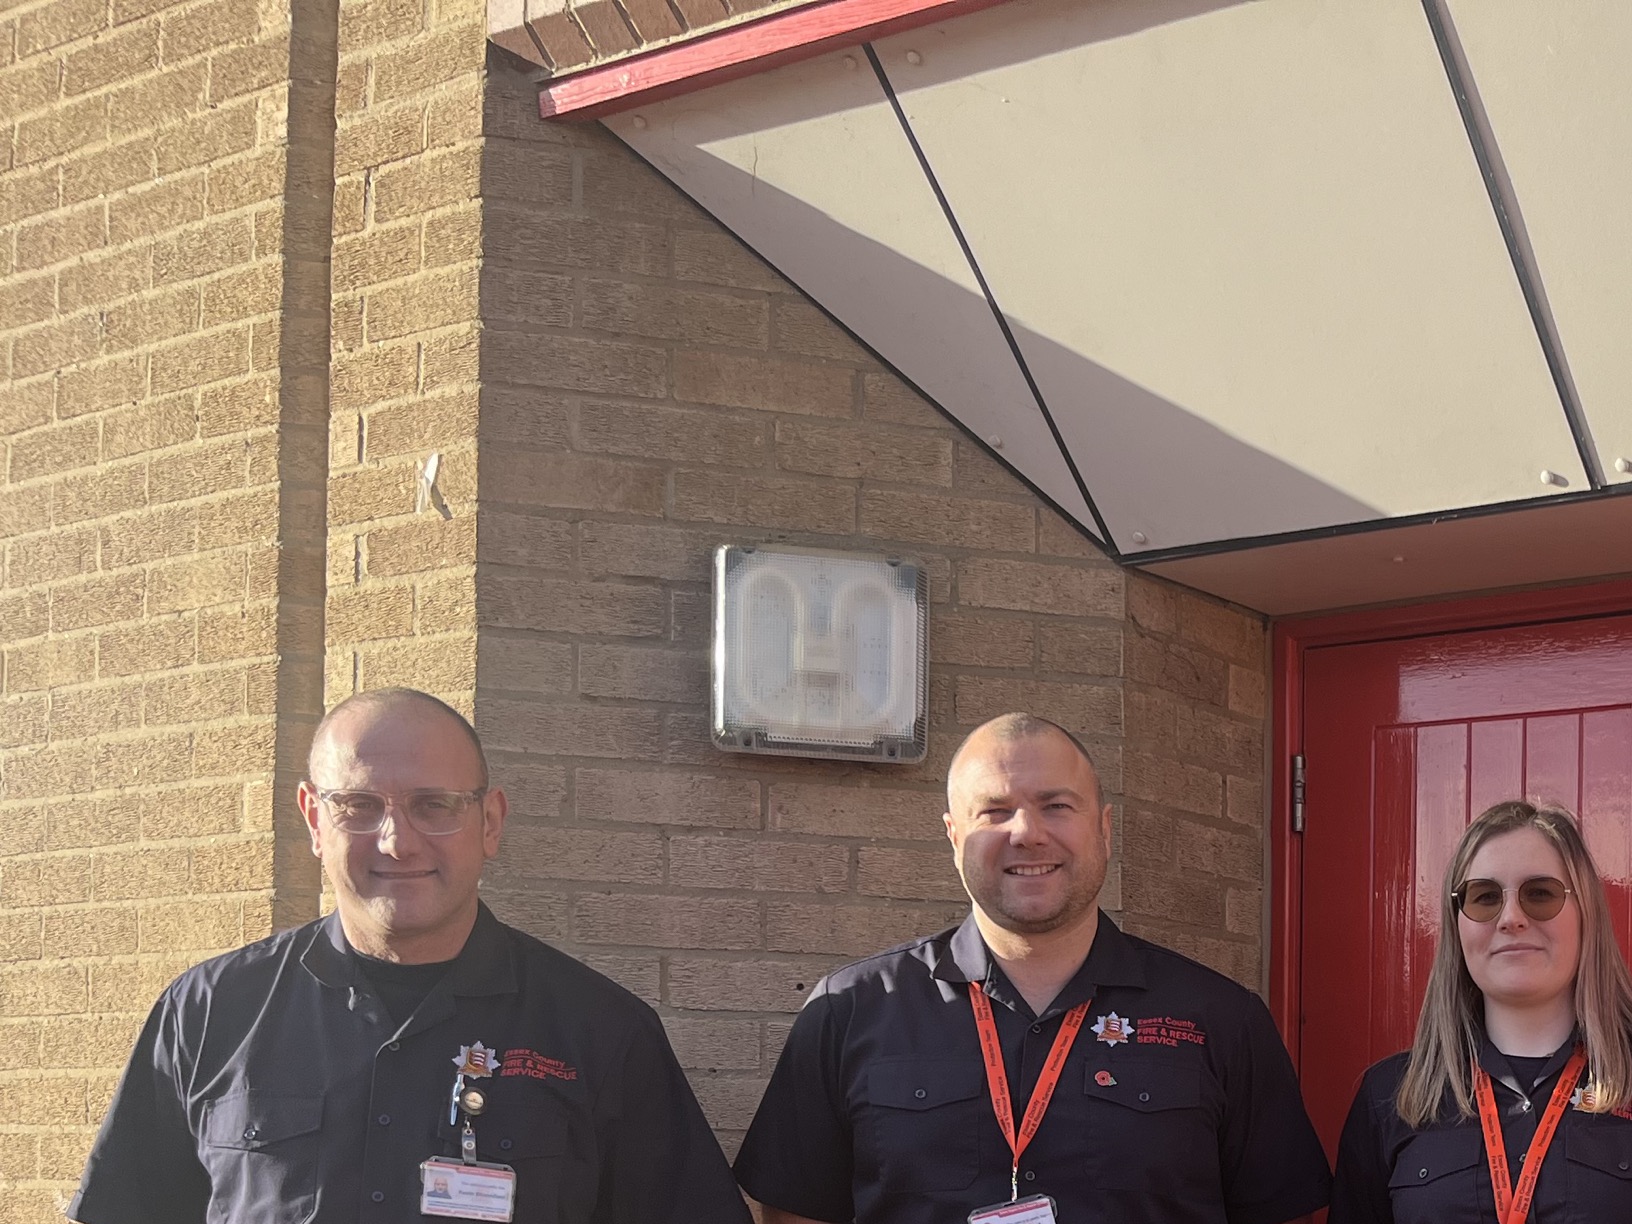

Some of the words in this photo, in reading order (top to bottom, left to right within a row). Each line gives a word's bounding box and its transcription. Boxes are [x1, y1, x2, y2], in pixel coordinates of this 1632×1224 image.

[1165, 1016, 1196, 1030] County
[1137, 1027, 1158, 1035] FIRE
[1160, 1027, 1167, 1036] &
[1170, 1030, 1205, 1045] RESCUE
[1137, 1035, 1178, 1047] SERVICE
[532, 1050, 566, 1068] County
[500, 1067, 546, 1079] SERVICE
[526, 1059, 534, 1068] &
[537, 1063, 577, 1080] RESCUE
